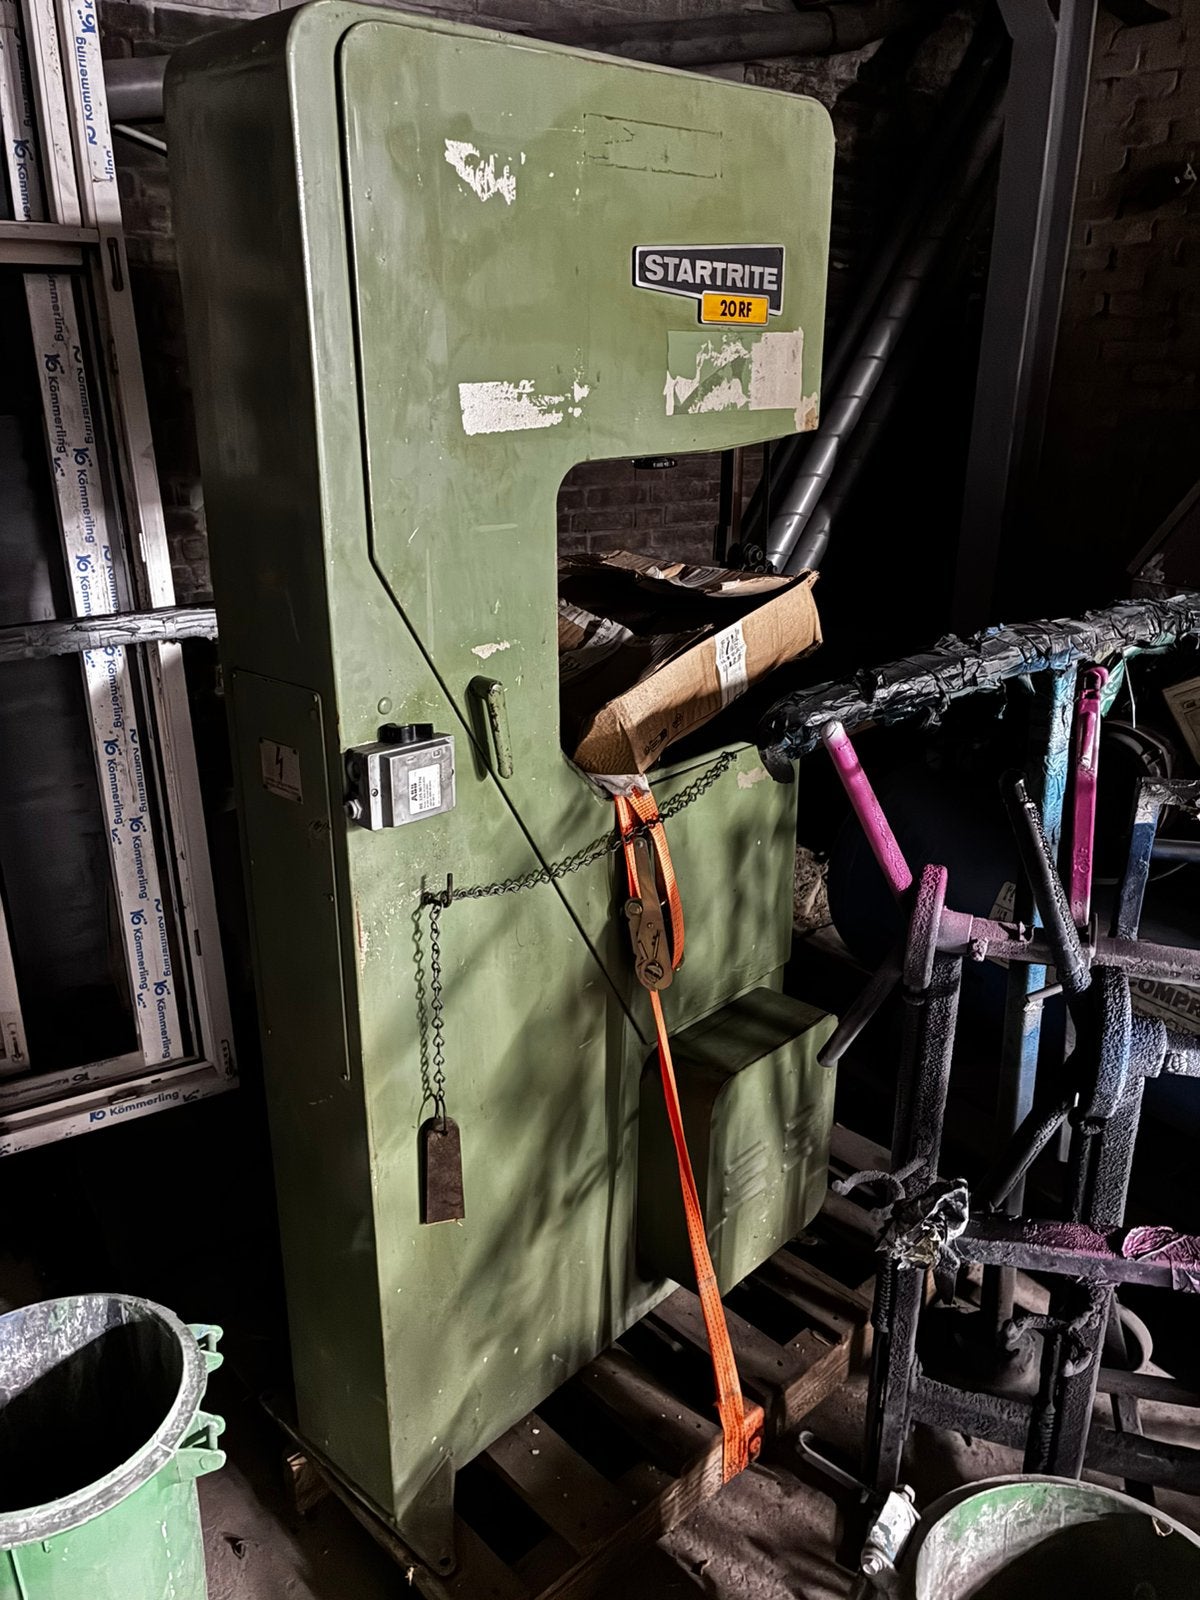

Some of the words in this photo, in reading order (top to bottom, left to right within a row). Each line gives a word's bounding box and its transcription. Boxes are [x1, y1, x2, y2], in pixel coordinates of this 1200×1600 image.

[644, 254, 778, 291] STARTRITE
[720, 299, 737, 317] 20
[738, 301, 752, 318] RF
[48, 376, 67, 453] Kömmerling
[77, 469, 96, 543] Kömmerling
[107, 660, 123, 728] Kömmerling
[107, 758, 124, 825] Kömmerling
[132, 835, 149, 899] Kömmerling
[133, 928, 149, 990] Kömmerling
[156, 999, 172, 1059] Kömmerling
[110, 1091, 180, 1116] Kömmerling
